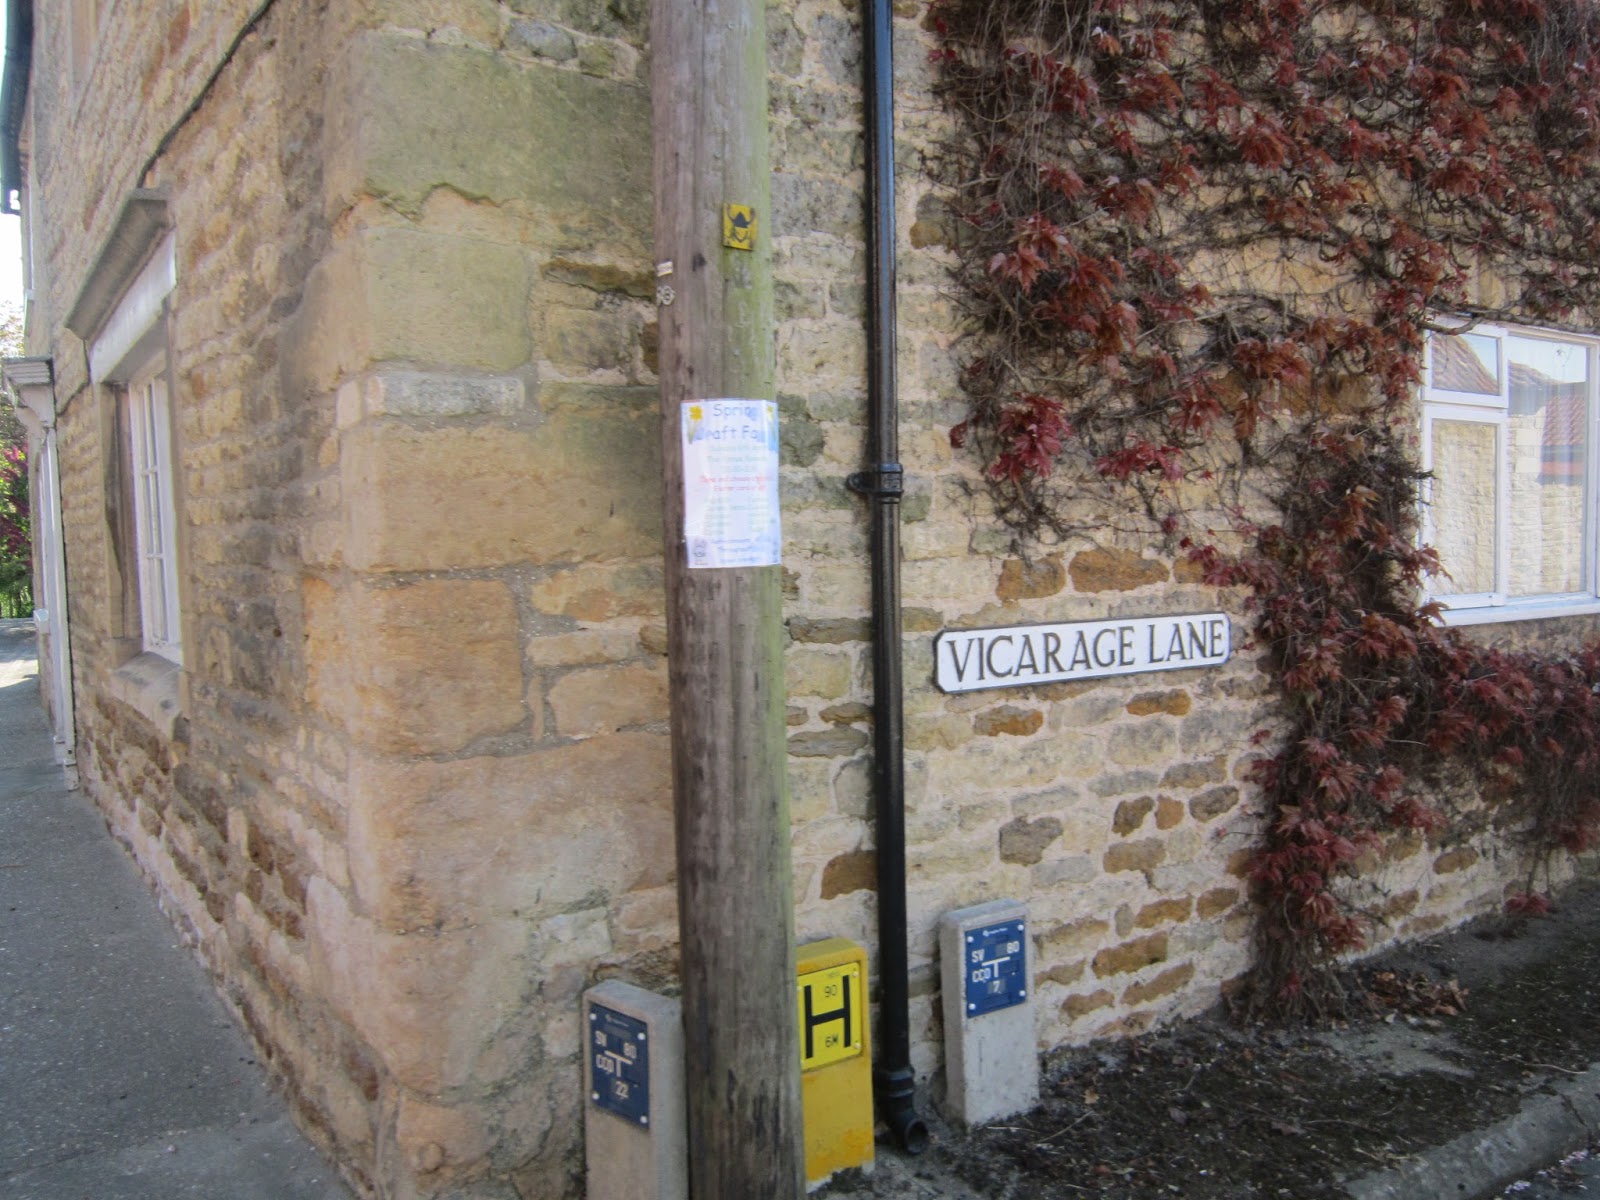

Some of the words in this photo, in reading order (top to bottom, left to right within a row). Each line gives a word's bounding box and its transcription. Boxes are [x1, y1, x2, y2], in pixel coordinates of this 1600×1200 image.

[946, 626, 1135, 682] VICARAGE
[1147, 620, 1225, 664] LANE
[804, 974, 851, 1060] H
